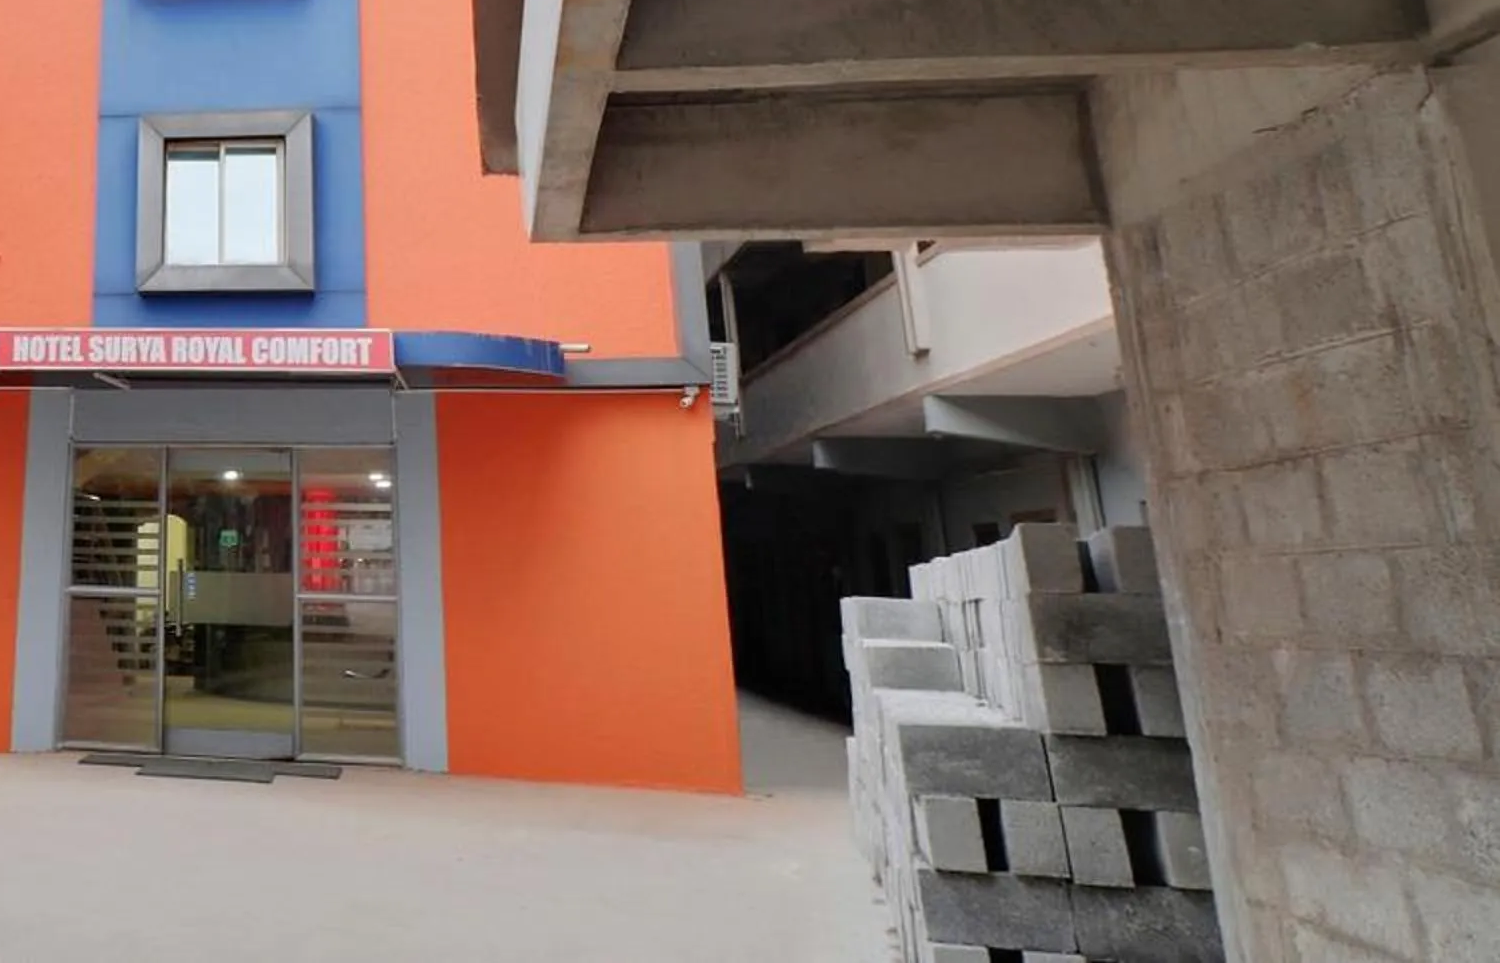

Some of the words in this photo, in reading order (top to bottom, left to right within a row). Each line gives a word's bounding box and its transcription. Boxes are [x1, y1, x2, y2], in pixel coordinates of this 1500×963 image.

[12, 334, 84, 363] HOTEL
[88, 335, 167, 364] SURYA
[171, 335, 246, 364] ROYAL
[251, 336, 372, 366] COMFORT
